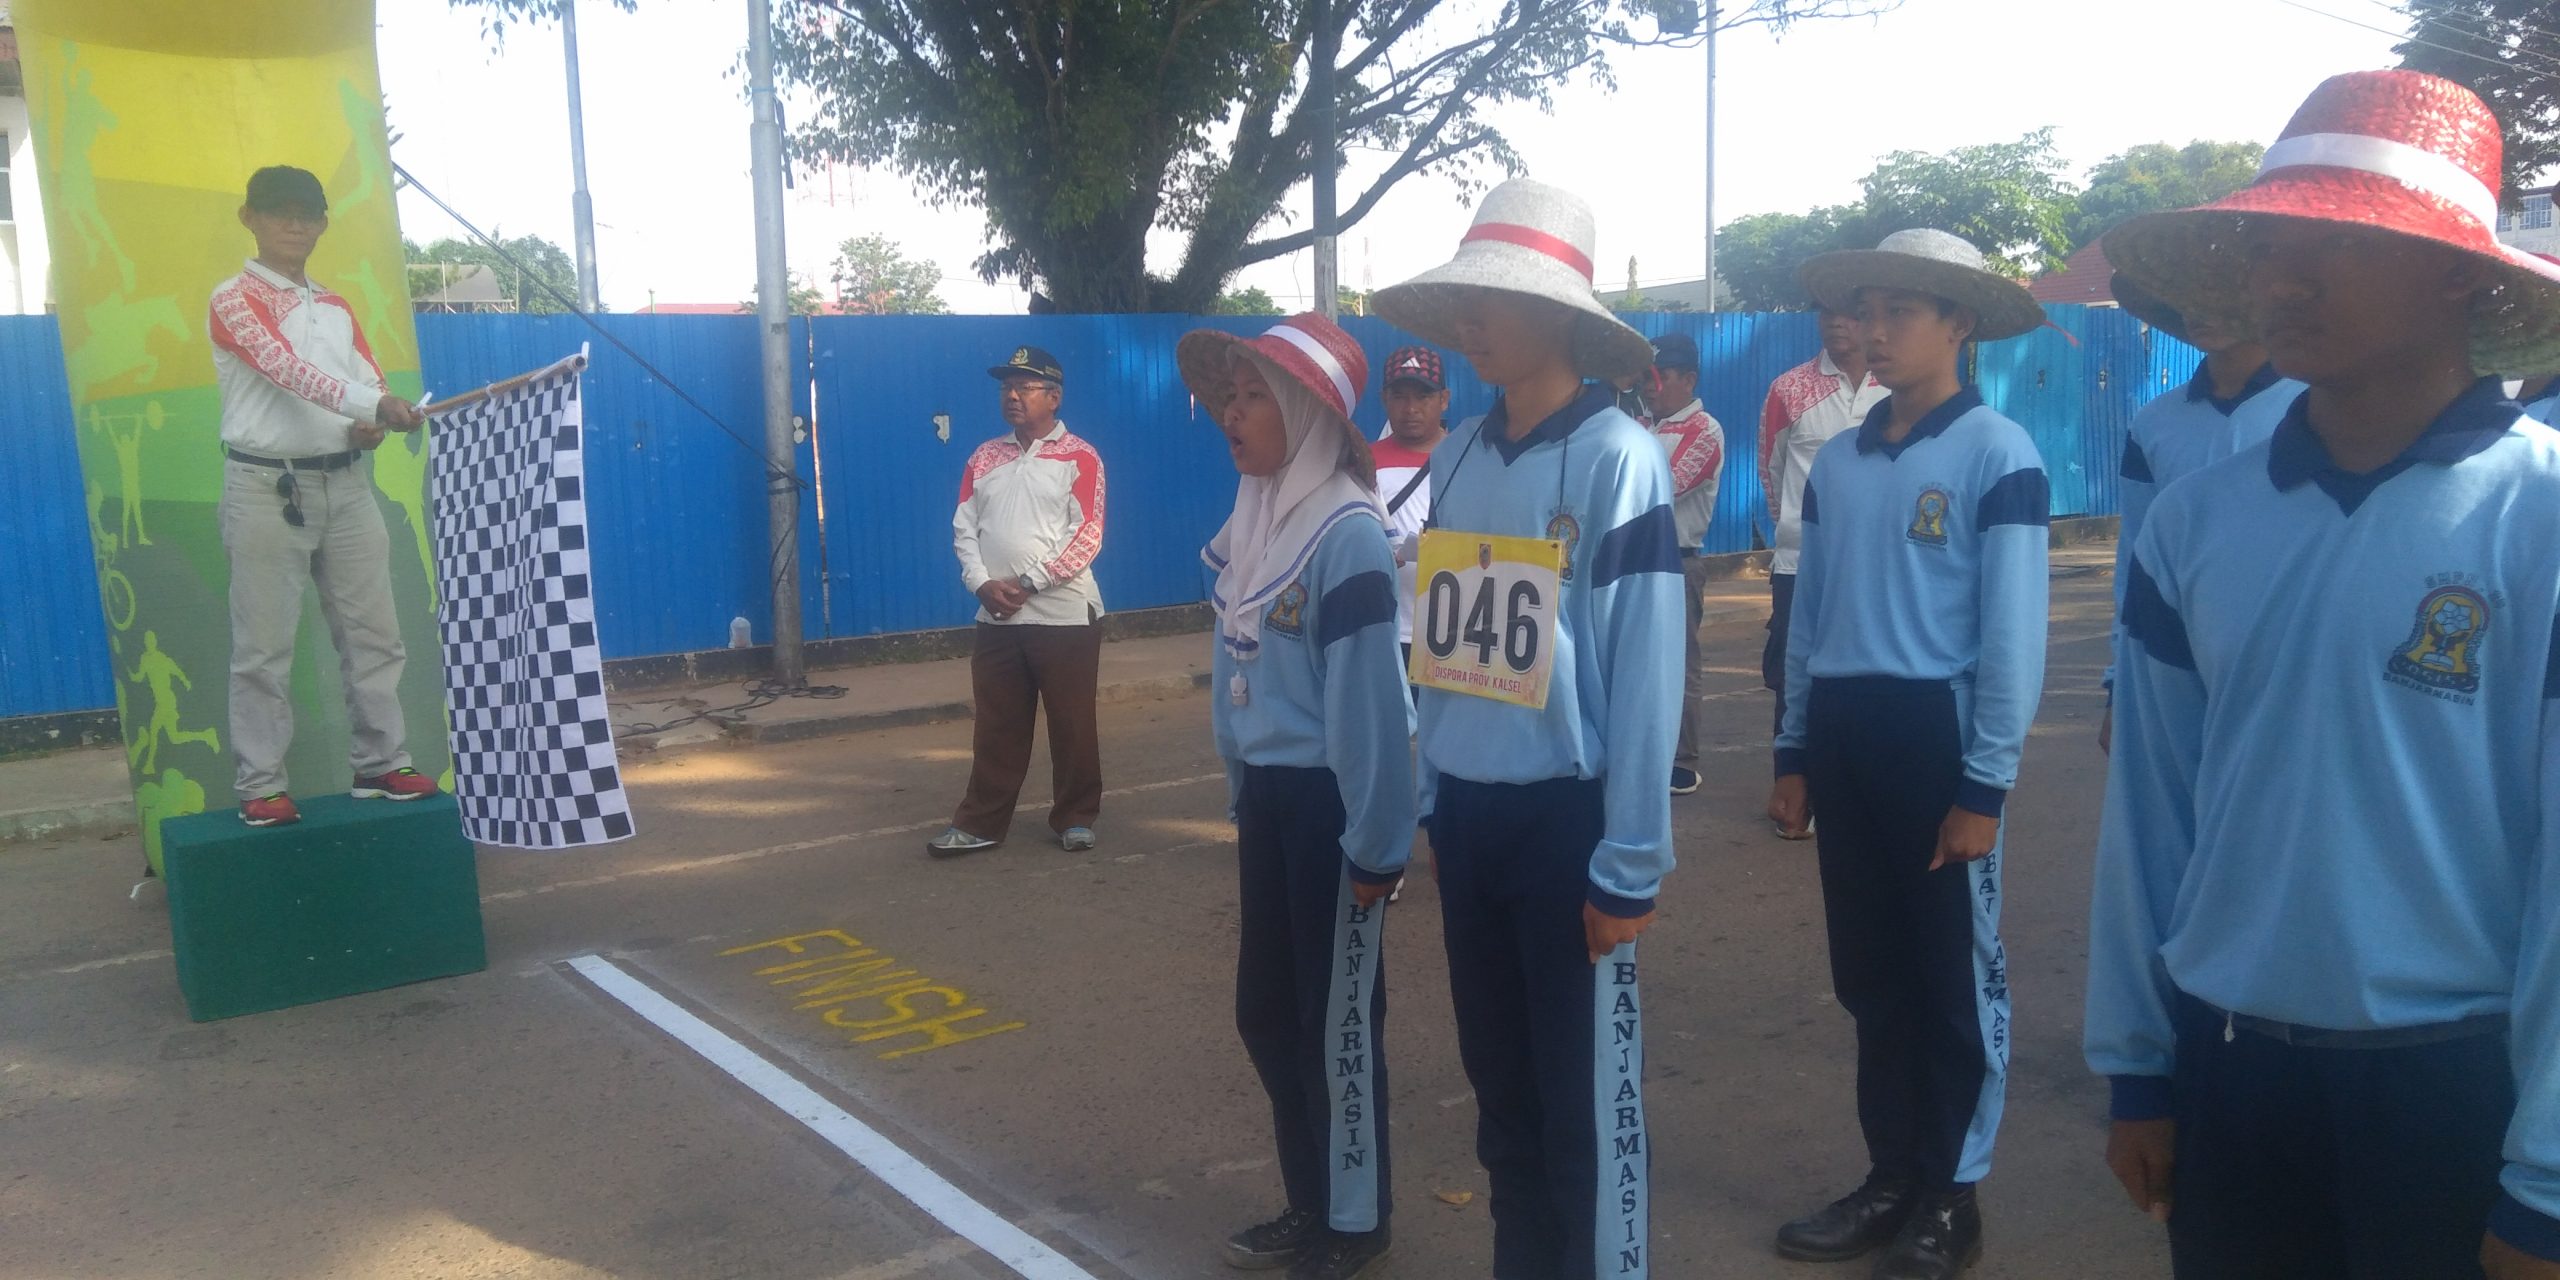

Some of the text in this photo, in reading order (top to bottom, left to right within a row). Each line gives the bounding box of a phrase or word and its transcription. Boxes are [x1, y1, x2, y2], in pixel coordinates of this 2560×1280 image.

[1426, 570, 1541, 672] 046
[1435, 666, 1467, 683] DISPORA
[1492, 677, 1521, 693] KALSEL
[715, 929, 1026, 1060] FINISH
[1336, 904, 1370, 1170] BANJARMASIN
[1612, 962, 1641, 1273] BANJARMASIN
